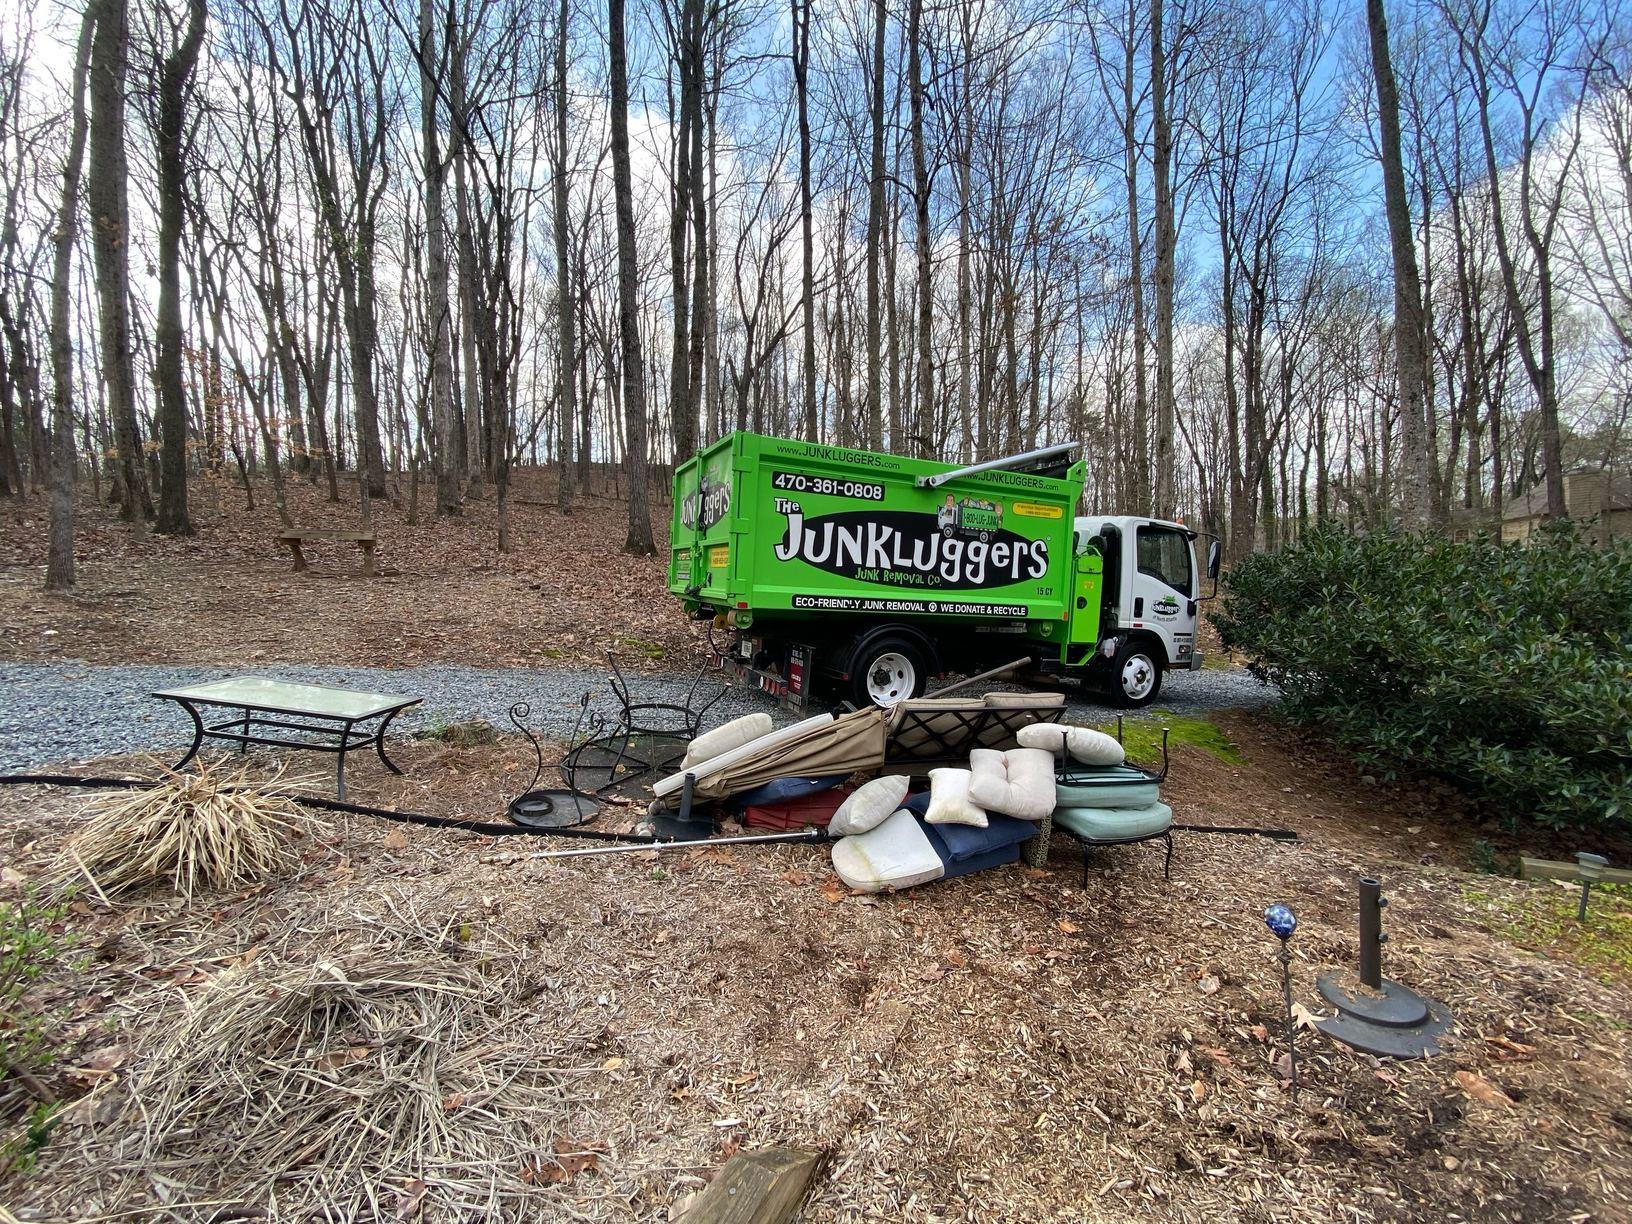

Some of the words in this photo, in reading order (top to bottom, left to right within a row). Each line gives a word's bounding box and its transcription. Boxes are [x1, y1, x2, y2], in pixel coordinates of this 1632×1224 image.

[777, 445, 900, 470] www.JUNKLUGGERS.com
[775, 473, 882, 500] 470-361-0808
[854, 566, 880, 581] JUNK
[1037, 587, 1045, 595] 15
[862, 601, 884, 610] JUNK
[886, 602, 925, 612] REMOVAL
[940, 603, 955, 612] WE
[956, 604, 985, 614] DONATE
[986, 605, 993, 614] &
[994, 606, 1026, 616] RECYCLE
